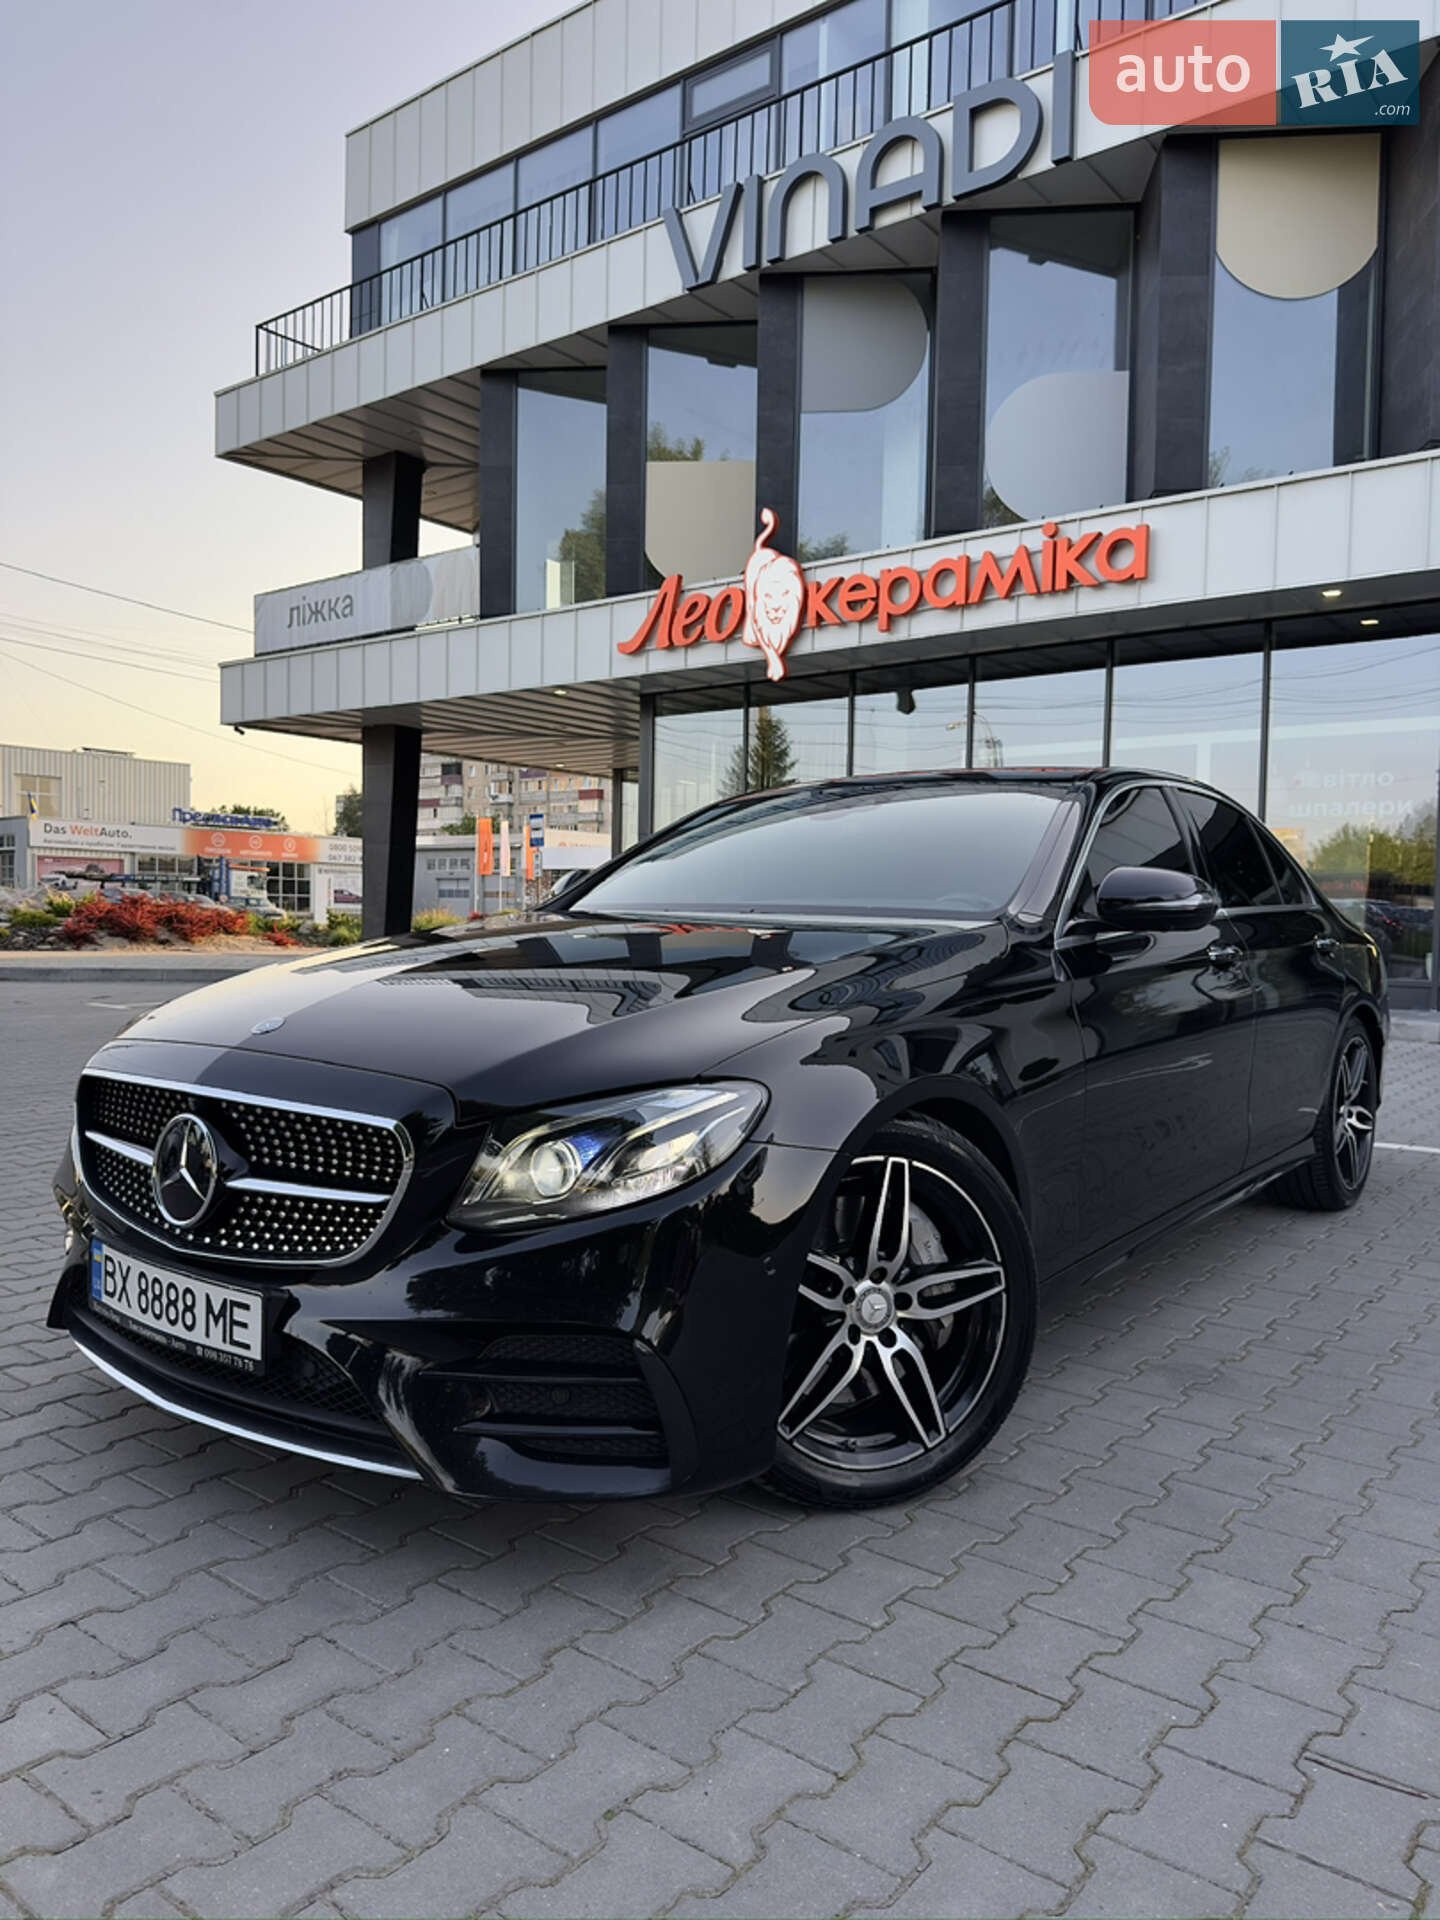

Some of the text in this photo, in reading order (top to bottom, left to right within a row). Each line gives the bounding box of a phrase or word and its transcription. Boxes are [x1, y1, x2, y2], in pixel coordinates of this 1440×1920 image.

[663, 48, 1076, 292] VINADI
[287, 594, 354, 629] ліжка
[617, 521, 1150, 656] Лео кераміка
[43, 823, 133, 839] Das WeltAuto.
[103, 1253, 132, 1309] BX
[137, 1270, 197, 1333] 8888
[205, 1291, 251, 1351] ME
